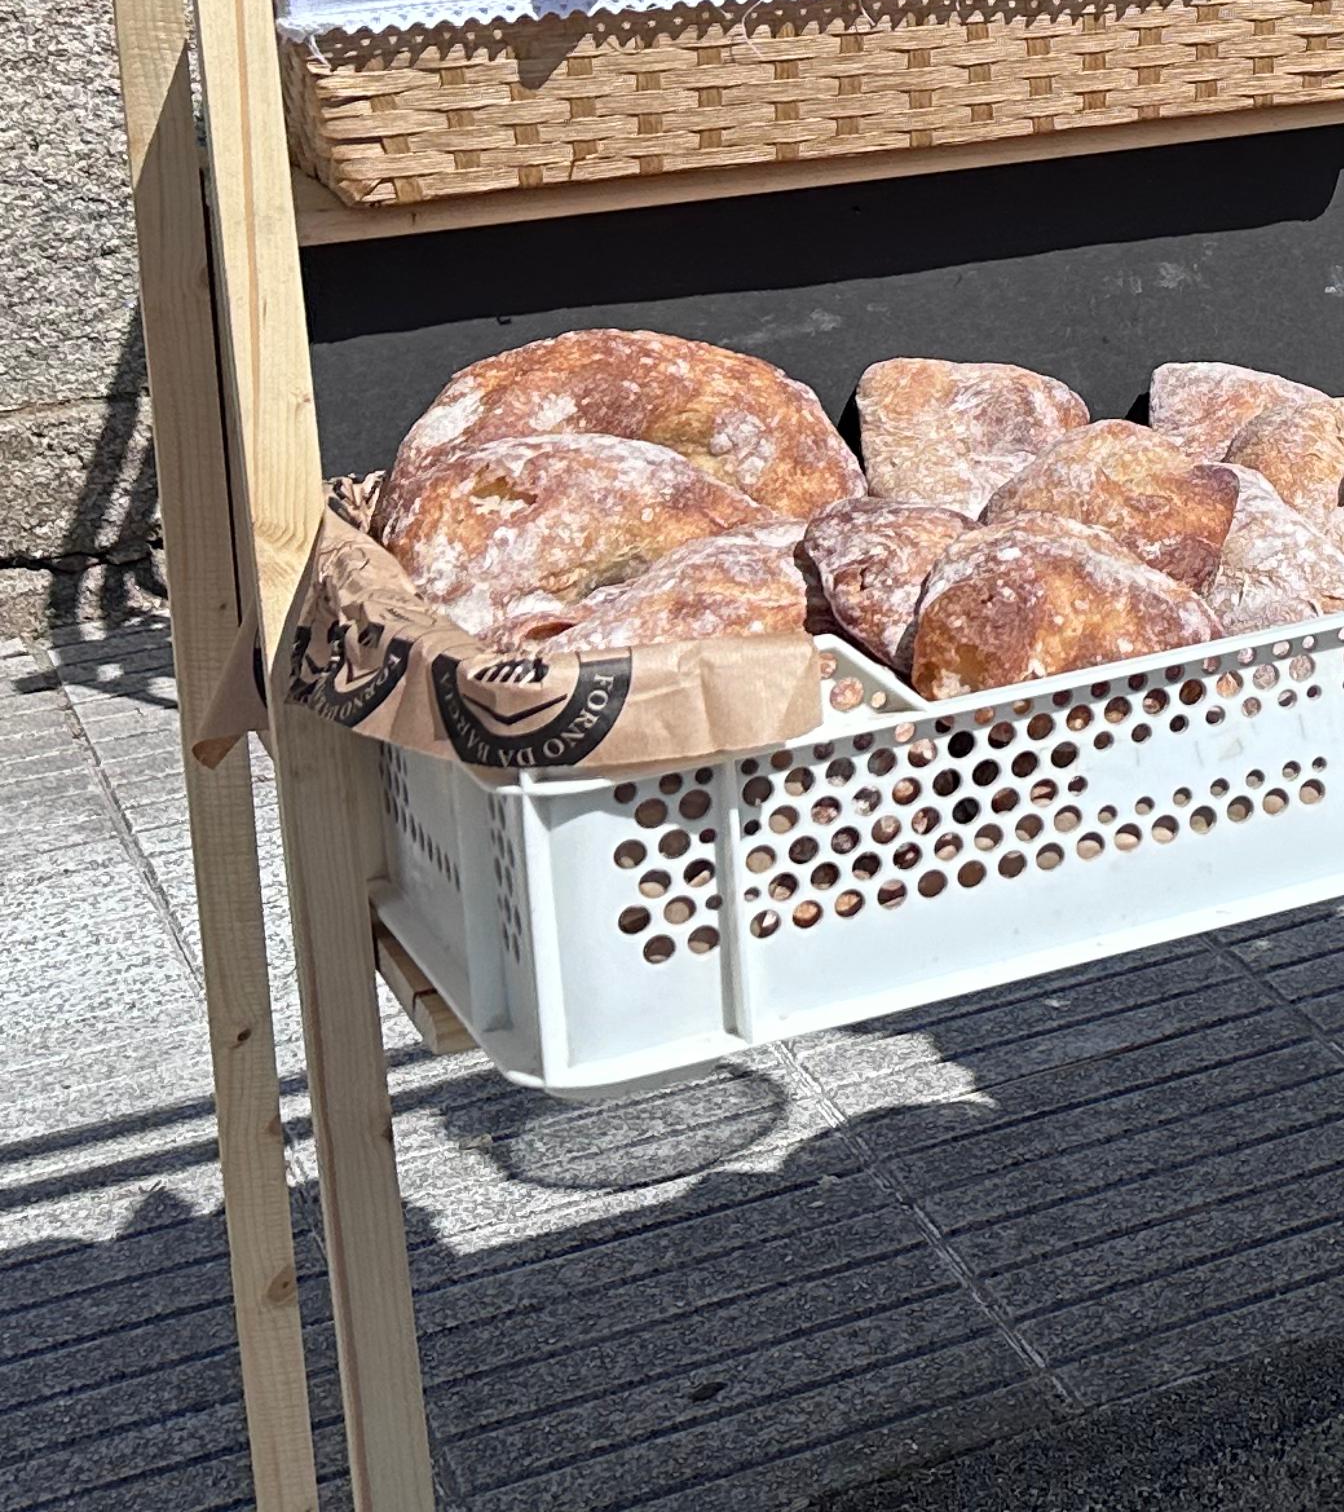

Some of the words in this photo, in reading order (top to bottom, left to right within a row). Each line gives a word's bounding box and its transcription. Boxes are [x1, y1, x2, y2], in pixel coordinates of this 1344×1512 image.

[440, 671, 491, 763] BARCIA
[498, 746, 536, 768] DA
[543, 673, 615, 759] FORNO
